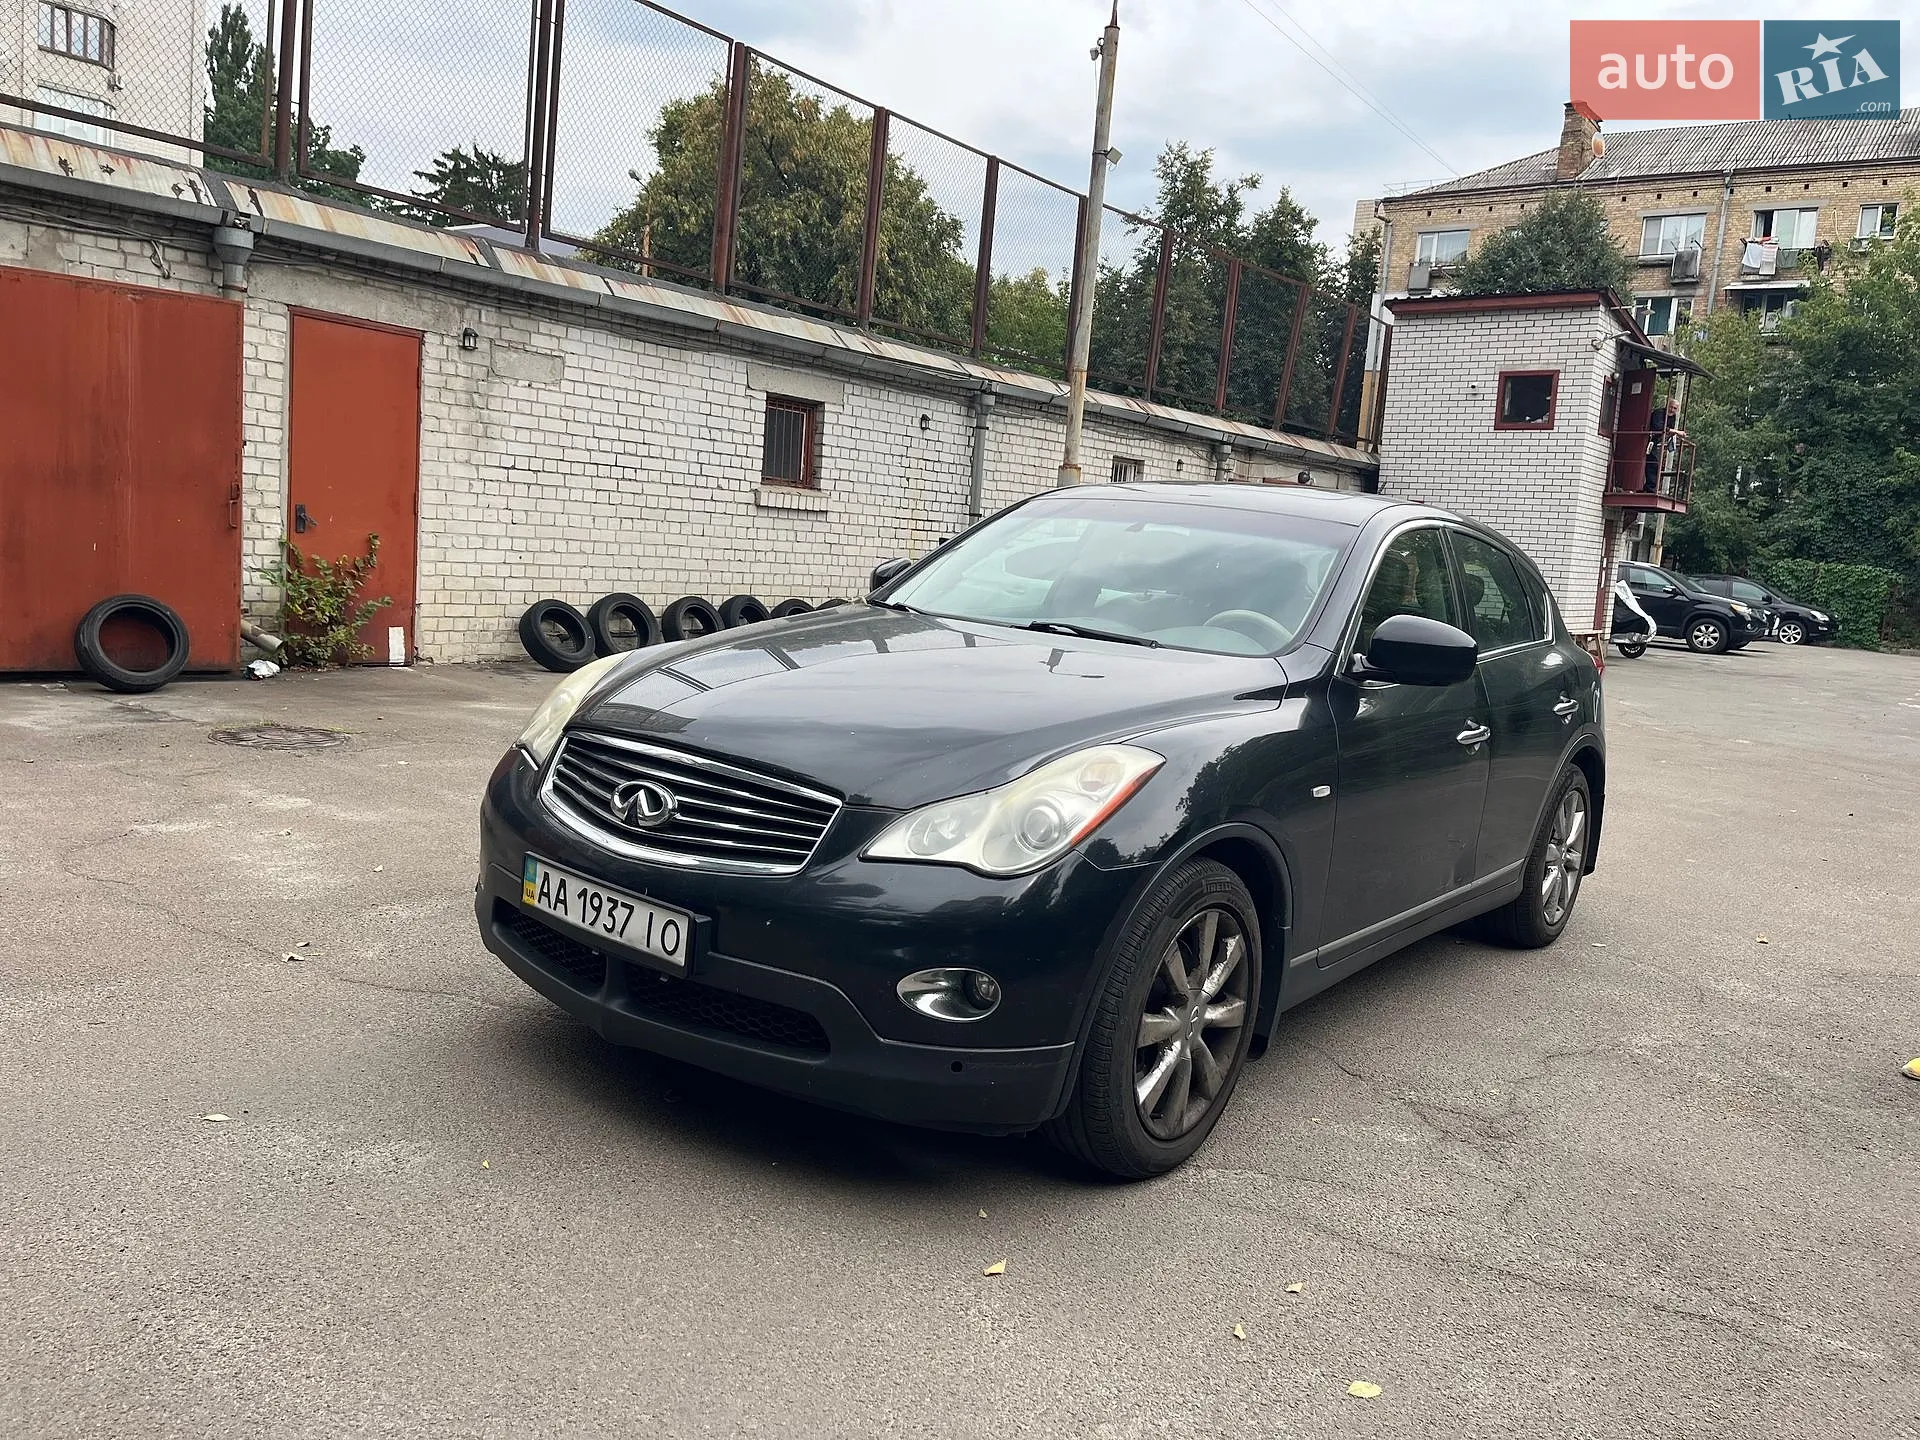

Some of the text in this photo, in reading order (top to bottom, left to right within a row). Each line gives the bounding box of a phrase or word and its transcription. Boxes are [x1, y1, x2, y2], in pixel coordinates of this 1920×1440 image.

[525, 887, 535, 900] UA
[537, 871, 569, 916] AA
[577, 887, 634, 939] 1937
